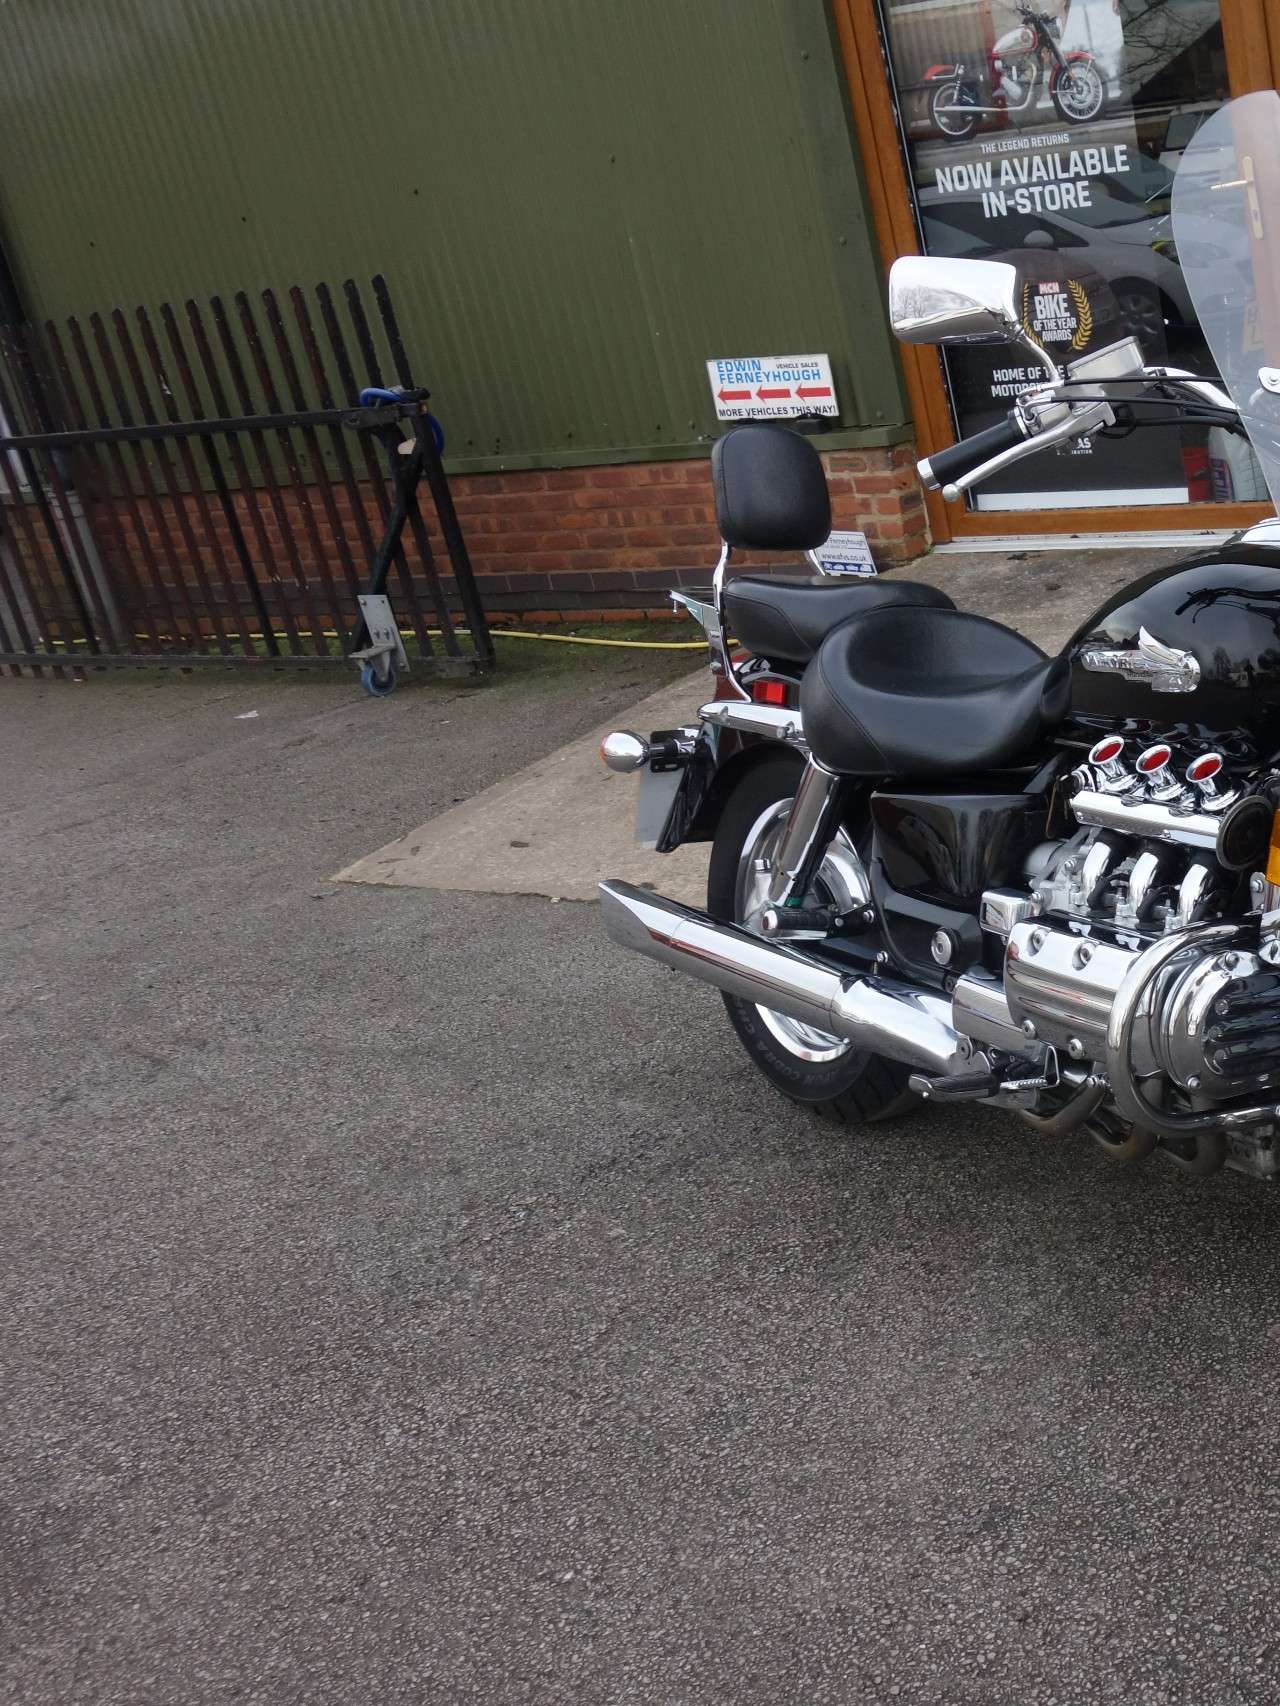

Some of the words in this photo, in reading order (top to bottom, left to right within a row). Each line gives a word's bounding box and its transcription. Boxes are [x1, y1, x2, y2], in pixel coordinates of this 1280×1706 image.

[981, 143, 996, 154] THE
[998, 138, 1030, 153] LEGEND
[1031, 133, 1070, 150] RETURNS
[935, 161, 992, 194] NOW
[1000, 144, 1130, 186] AVAILABLE
[981, 180, 1092, 218] IN-STORE
[1034, 293, 1071, 319] BIKE
[1033, 320, 1043, 331] OF
[1043, 318, 1058, 330] THE
[1057, 317, 1077, 330] YEAR
[1042, 329, 1073, 342] AWARDS
[717, 360, 761, 373] EDWIN
[993, 367, 1026, 382] HOME
[1027, 366, 1041, 380] OF
[1043, 365, 1065, 379] TE
[719, 369, 821, 384] FERNEYHOUGH
[719, 408, 745, 417] MORE
[745, 406, 788, 416] VEHICLES
[790, 406, 812, 415] THIS
